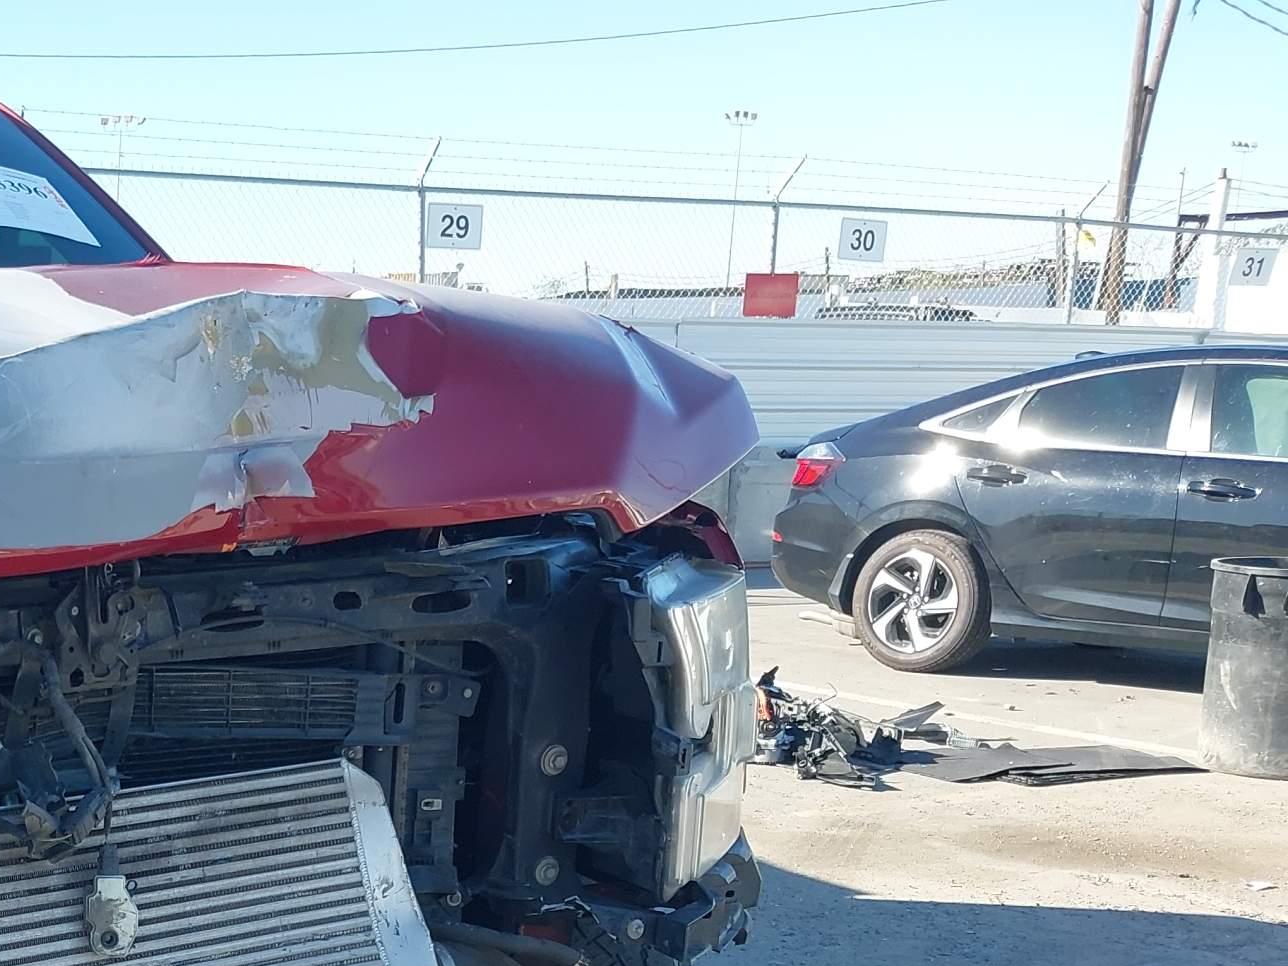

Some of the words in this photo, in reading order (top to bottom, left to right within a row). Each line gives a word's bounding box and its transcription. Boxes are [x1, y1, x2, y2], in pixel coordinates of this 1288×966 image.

[440, 214, 469, 239] 29
[850, 228, 875, 252] 30
[1242, 256, 1265, 277] 31
